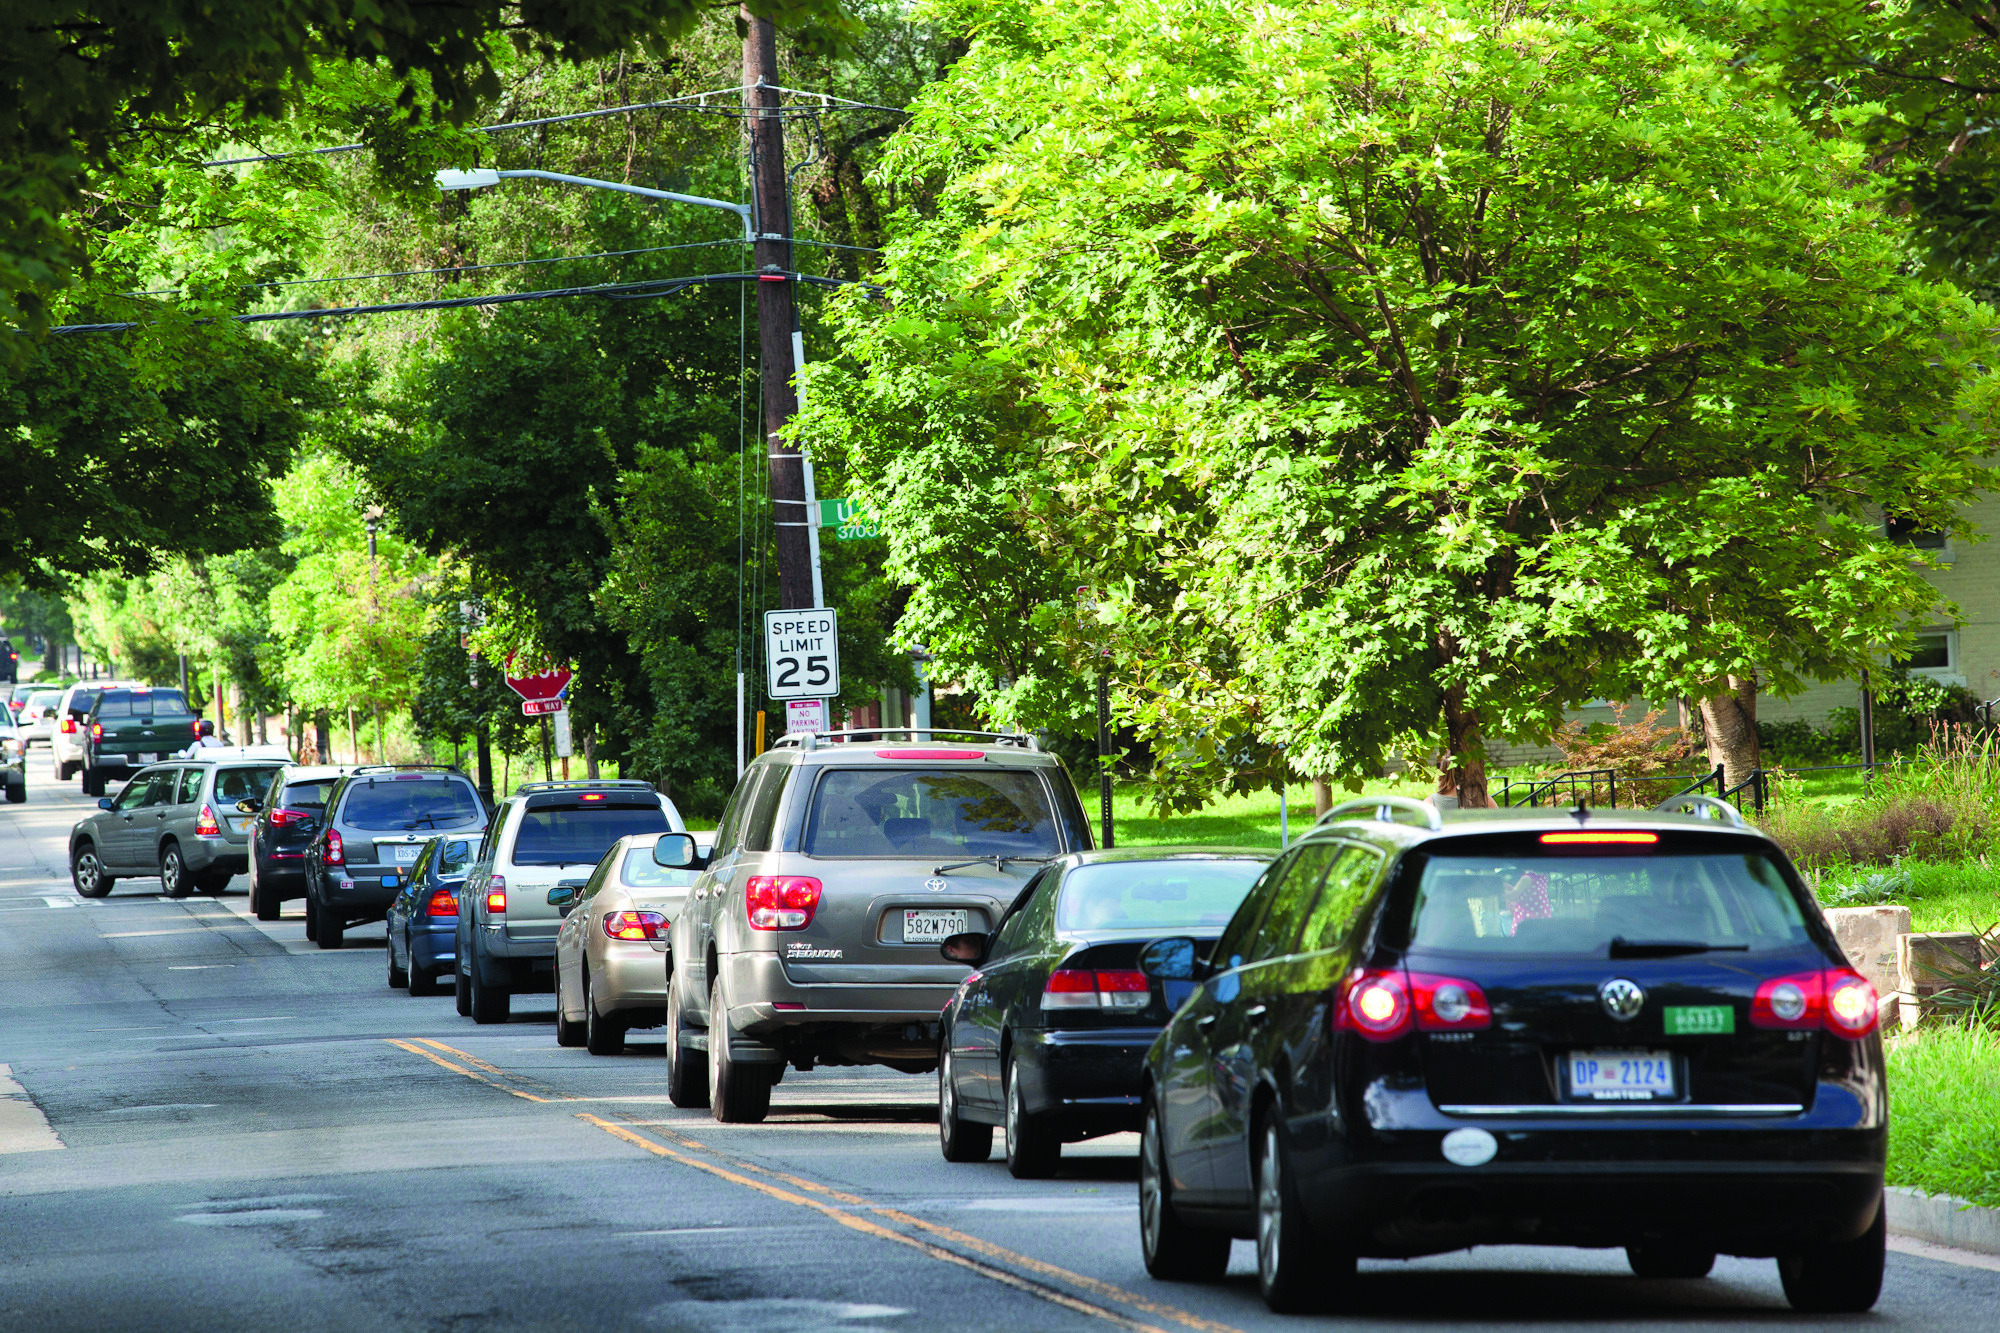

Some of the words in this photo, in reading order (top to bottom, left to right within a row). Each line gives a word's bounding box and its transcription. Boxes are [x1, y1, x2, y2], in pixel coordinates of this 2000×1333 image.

[838, 524, 877, 539] 3700
[772, 620, 831, 635] SPEED
[780, 638, 823, 652] LIMIT
[775, 655, 831, 688] 25
[526, 704, 541, 713] ALL
[544, 702, 561, 711] WAY
[799, 710, 810, 718] NO
[791, 718, 819, 727] PARKING
[907, 918, 964, 934] 582M790
[786, 949, 843, 959] SEQUOIA
[1575, 1060, 1598, 1085] DP
[1620, 1060, 1666, 1085] 2124
